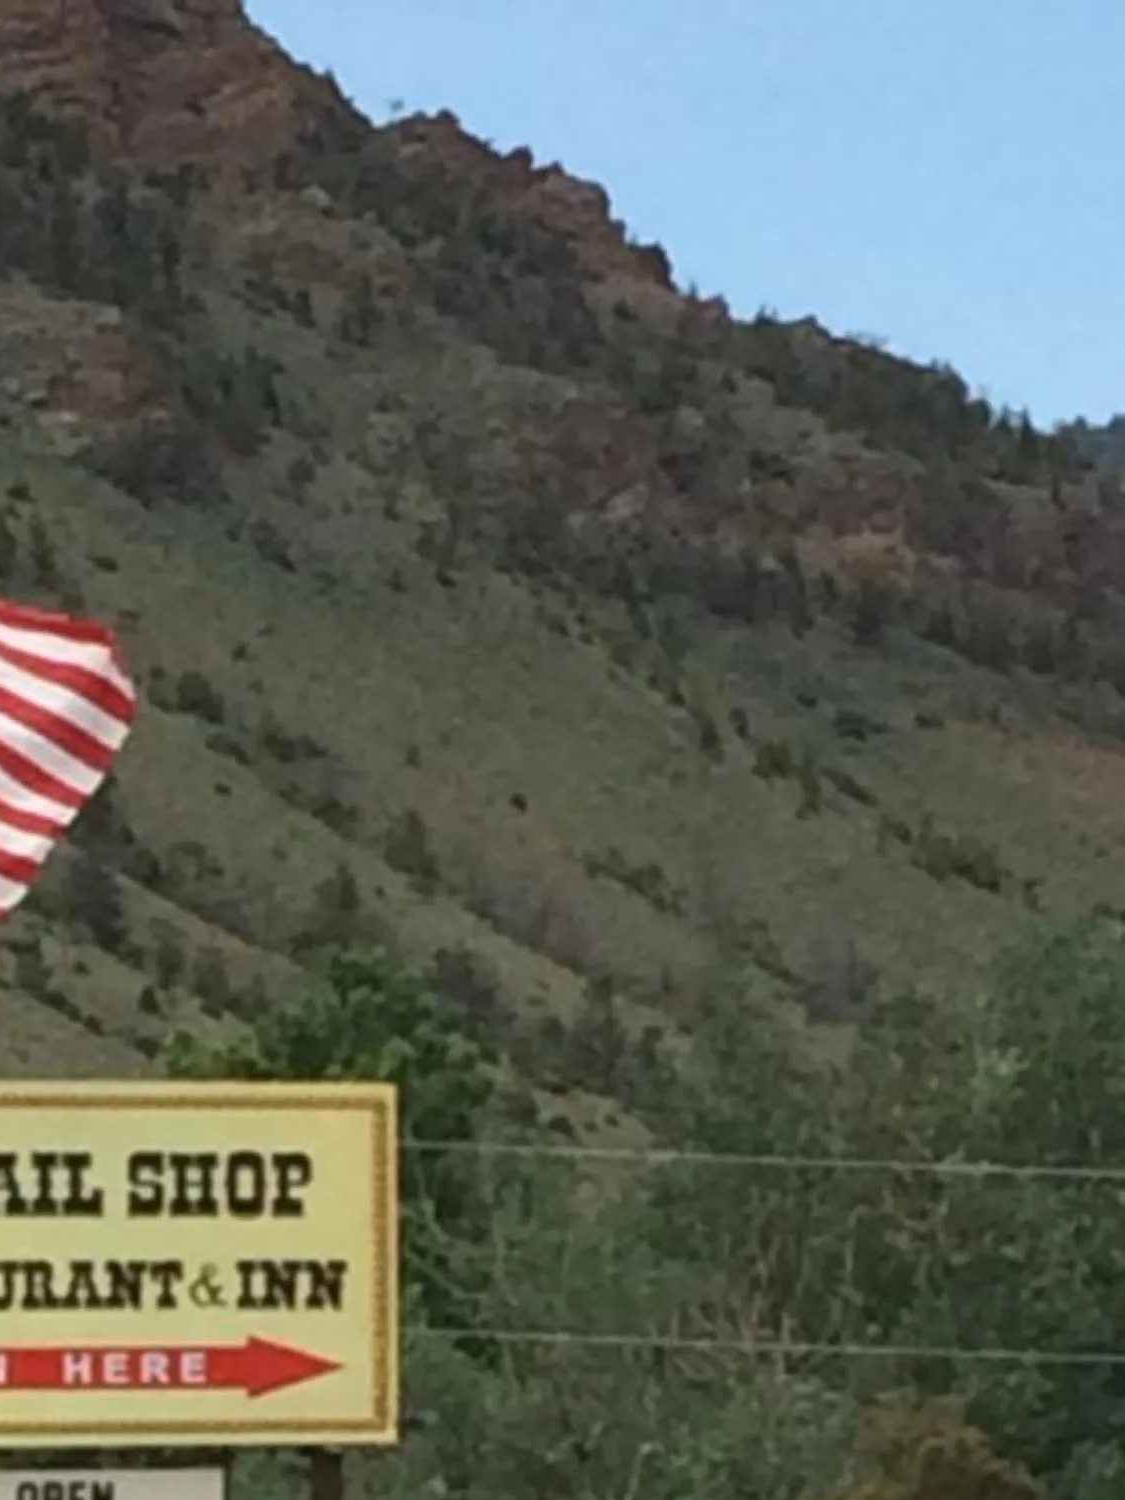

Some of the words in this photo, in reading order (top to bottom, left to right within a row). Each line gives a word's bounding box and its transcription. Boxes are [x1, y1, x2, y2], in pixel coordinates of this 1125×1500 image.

[127, 1151, 312, 1217] SHOP
[188, 1263, 227, 1307] &
[235, 1260, 348, 1310] INN
[62, 1351, 209, 1384] HERE
